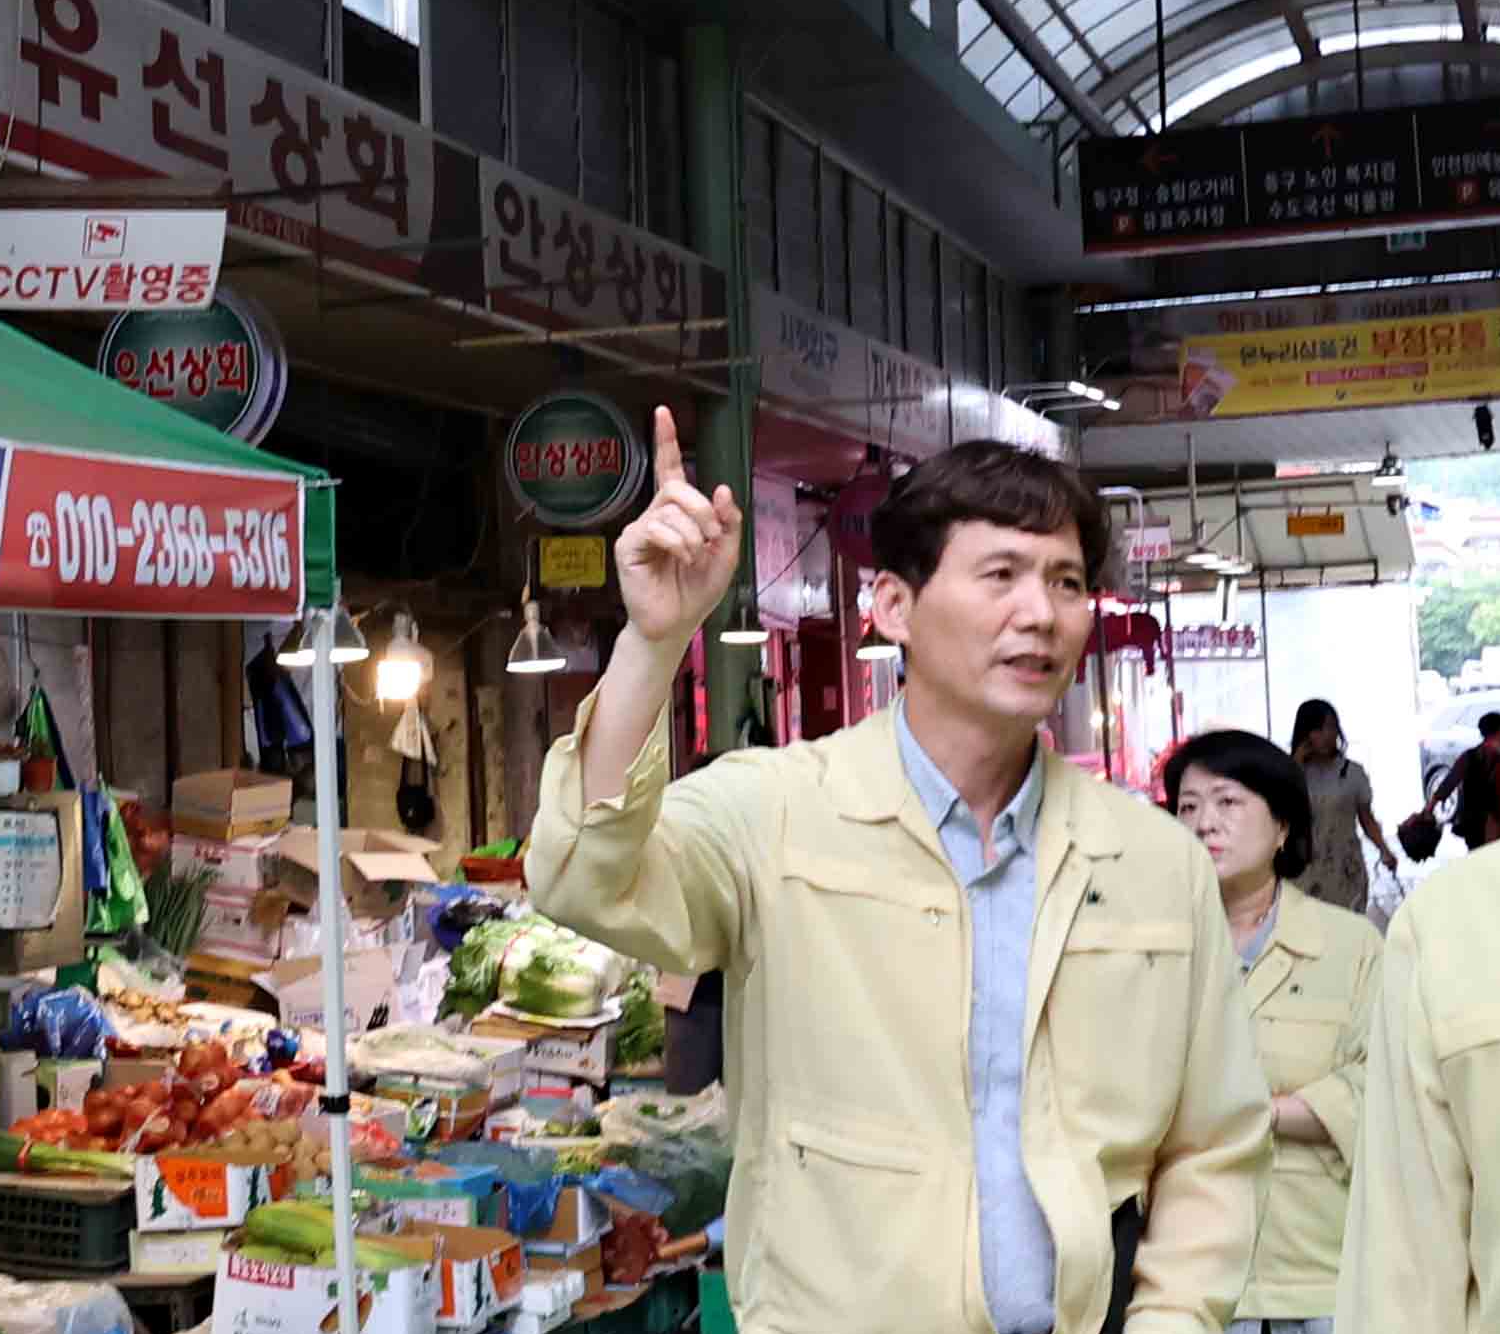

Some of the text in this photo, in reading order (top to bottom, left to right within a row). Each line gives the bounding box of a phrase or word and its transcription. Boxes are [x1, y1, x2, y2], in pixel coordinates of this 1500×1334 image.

[1305, 164, 1336, 188] 노인
[494, 182, 688, 329] 안성상회
[56, 491, 292, 591] 010-2368-5316
